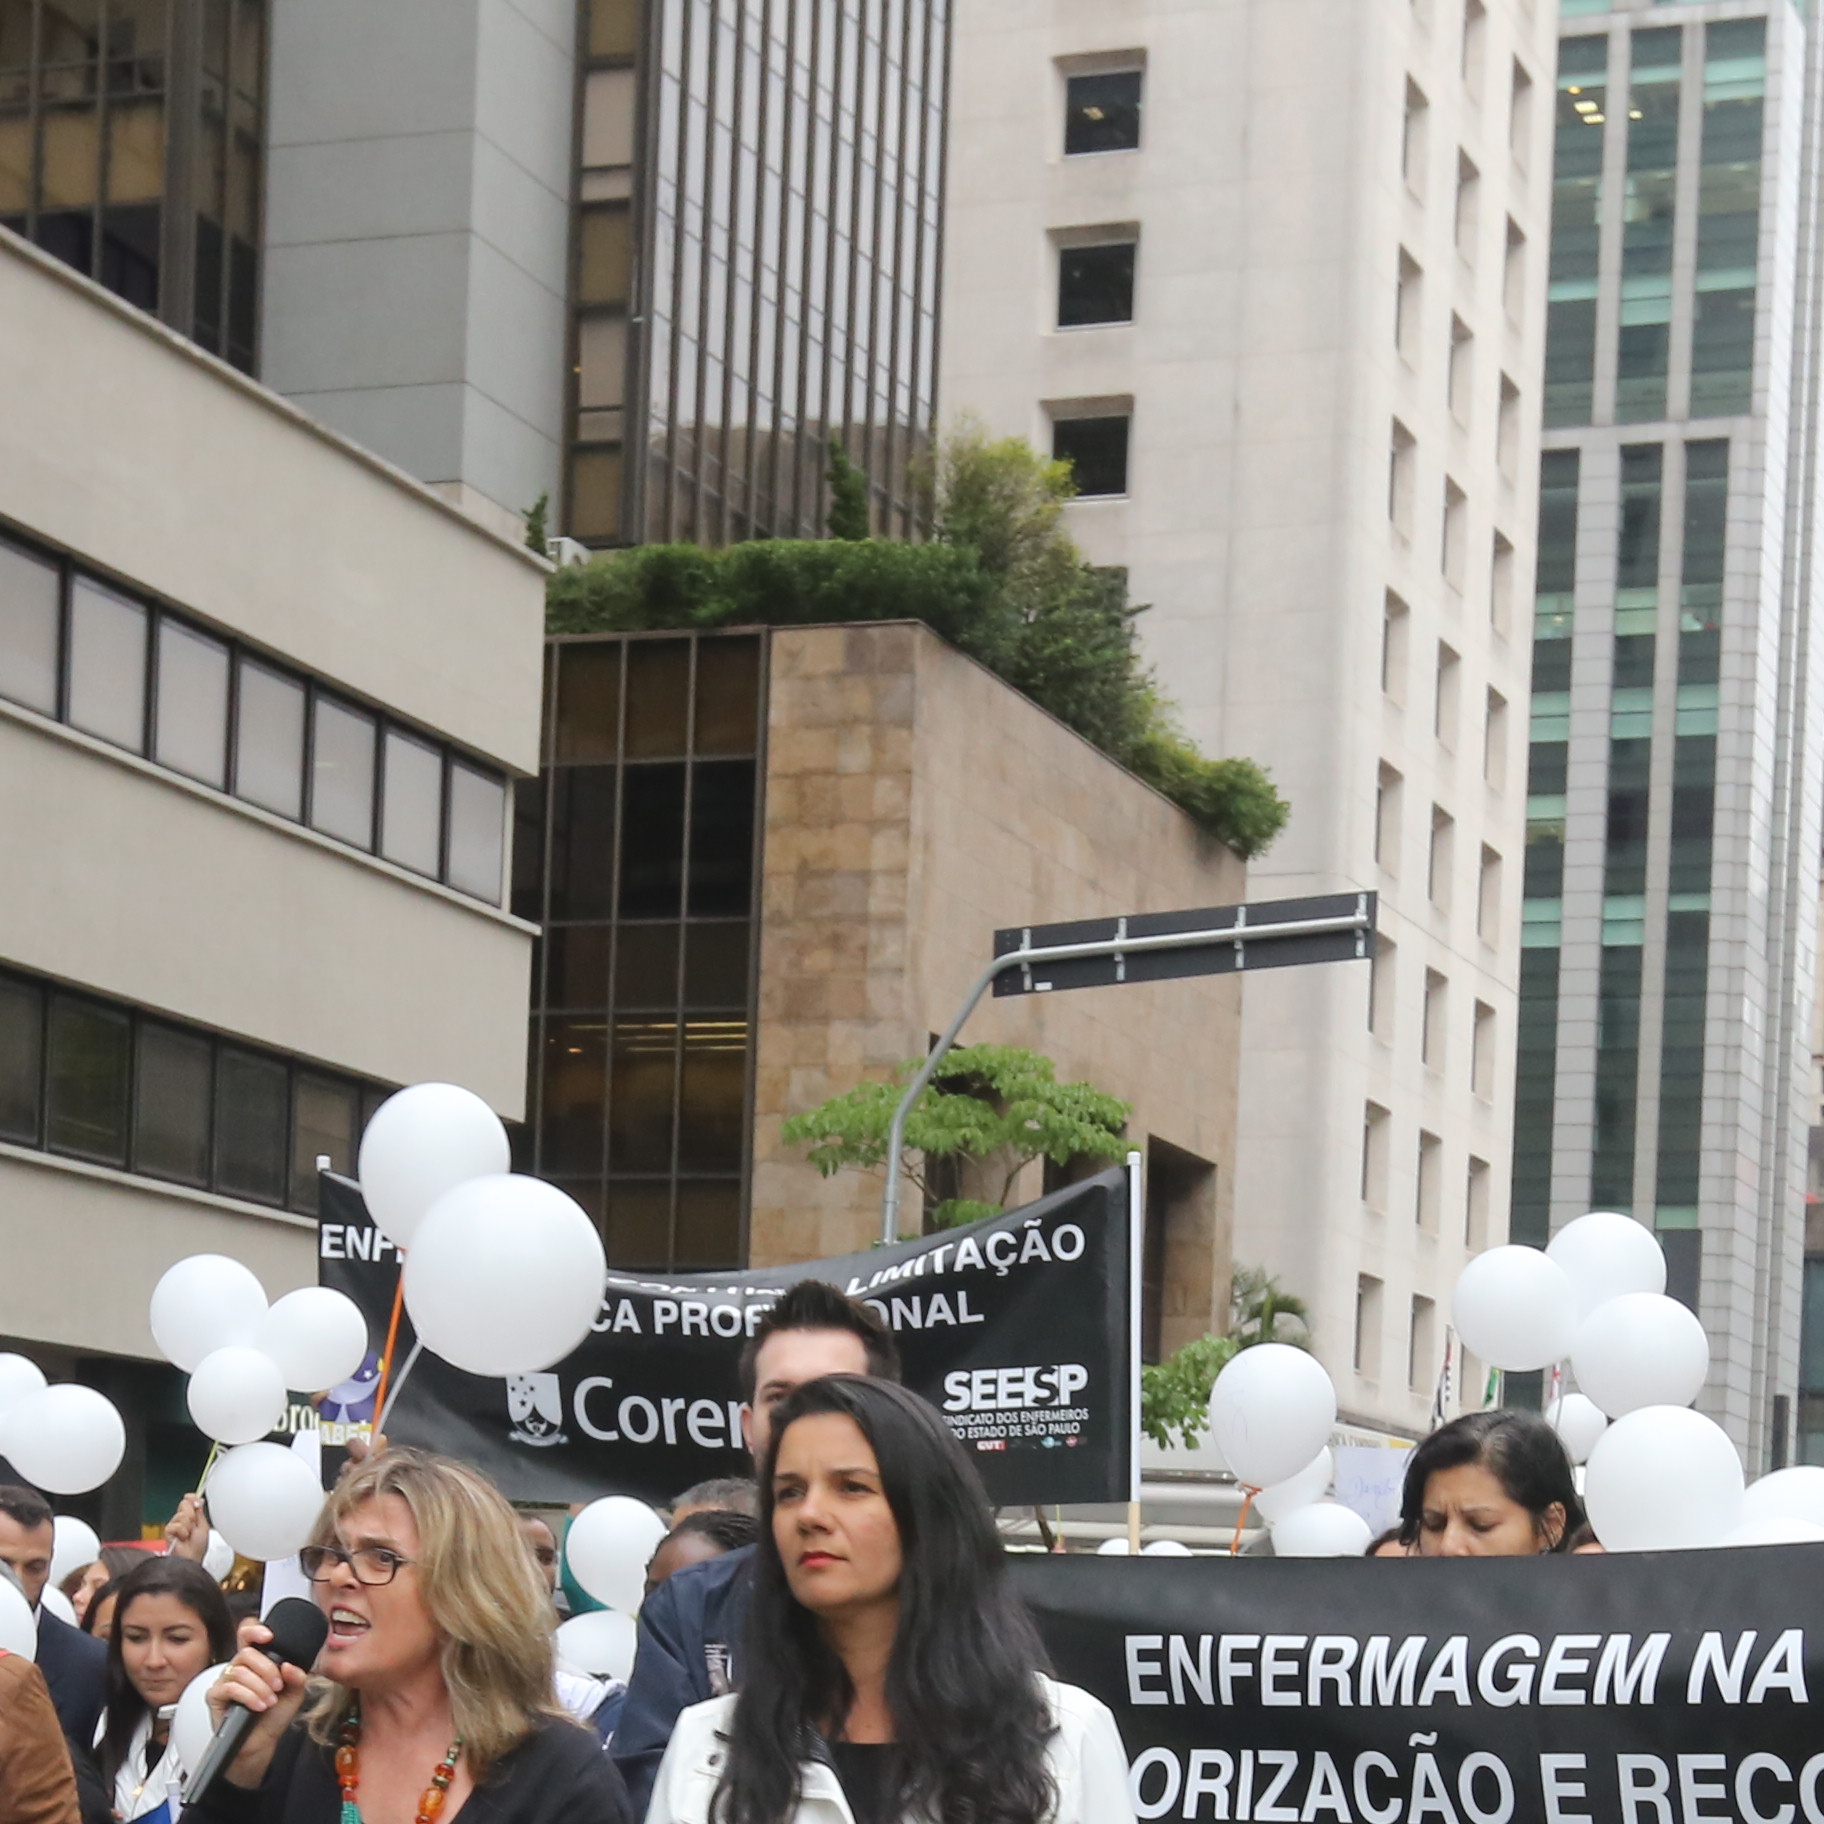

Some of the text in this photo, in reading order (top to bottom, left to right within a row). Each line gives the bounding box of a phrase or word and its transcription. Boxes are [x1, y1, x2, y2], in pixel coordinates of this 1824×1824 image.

[321, 1219, 1086, 1297] ENF LIMITAÇÃO
[942, 1363, 1089, 1412] SEESP
[967, 1425, 1007, 1439] ESTADO
[1009, 1423, 1023, 1437] DE
[1025, 1421, 1047, 1436] SÃO
[1048, 1422, 1080, 1435] PAULO
[996, 1411, 1019, 1425] DOS
[1020, 1408, 1089, 1422] ENFERMEIROS
[1124, 1632, 1672, 1708] ENFERMAGEM
[1686, 1628, 1809, 1705] NA
